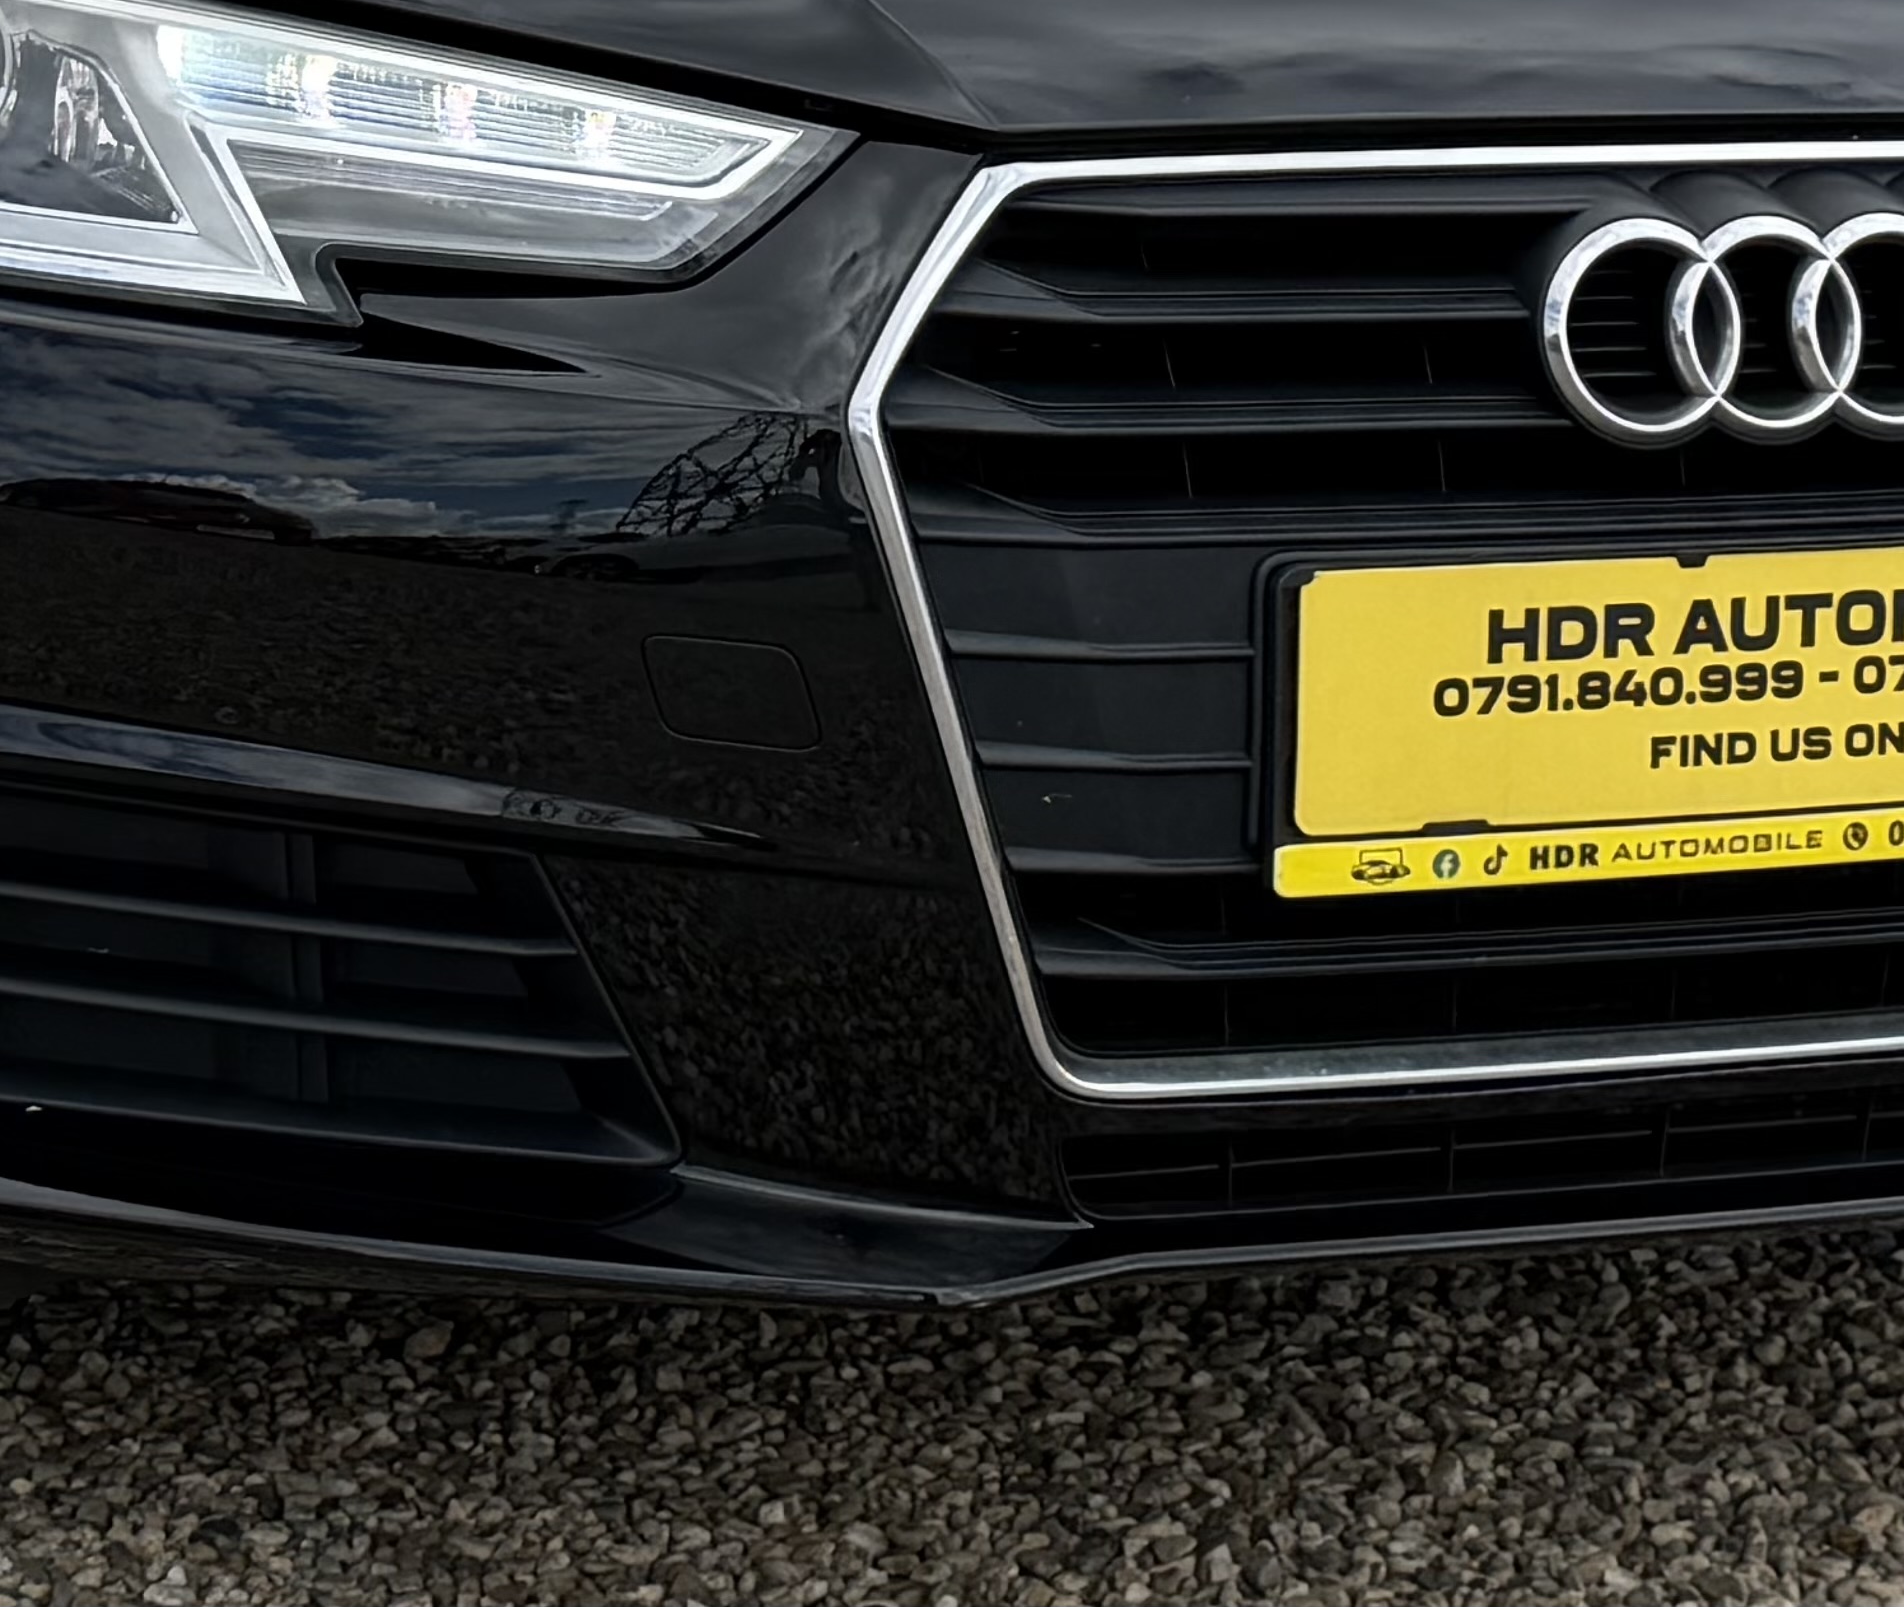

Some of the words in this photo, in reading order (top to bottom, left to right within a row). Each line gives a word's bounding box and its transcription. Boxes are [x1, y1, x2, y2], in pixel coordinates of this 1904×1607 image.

[1487, 602, 1655, 665] HDR
[1433, 660, 1804, 717] 0791.840.999
[1650, 732, 1757, 769] FIND
[1770, 726, 1832, 762] US
[1529, 843, 1599, 870] HDR
[1612, 830, 1823, 862] AUTOMOBILE
